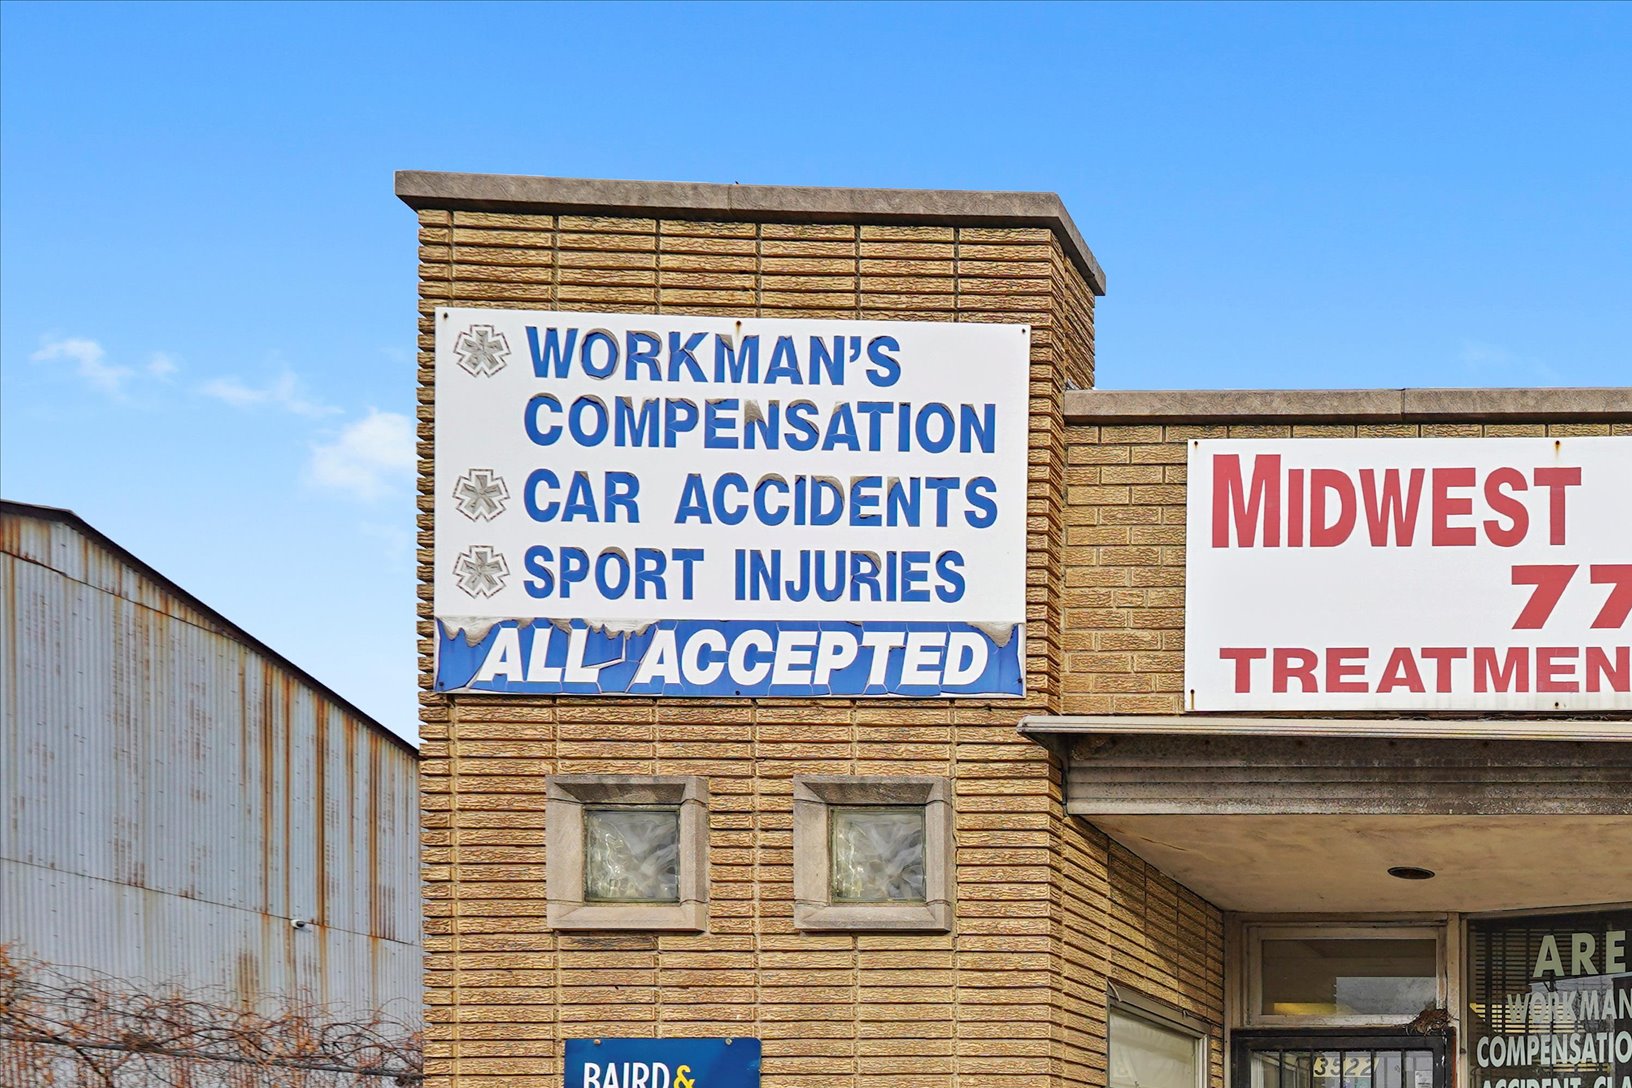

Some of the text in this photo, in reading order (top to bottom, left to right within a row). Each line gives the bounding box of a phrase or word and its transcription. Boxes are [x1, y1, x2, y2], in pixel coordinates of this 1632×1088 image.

[526, 326, 901, 387] WORKMAN'S
[524, 392, 996, 453] COMPENSATION
[523, 468, 998, 529] CAR ACCIDENTS
[1211, 453, 1582, 548] MIDWEST
[524, 545, 966, 603] SPORT INJURIES
[475, 626, 989, 686] ALL ACCEPTED
[1533, 930, 1626, 978] ARE
